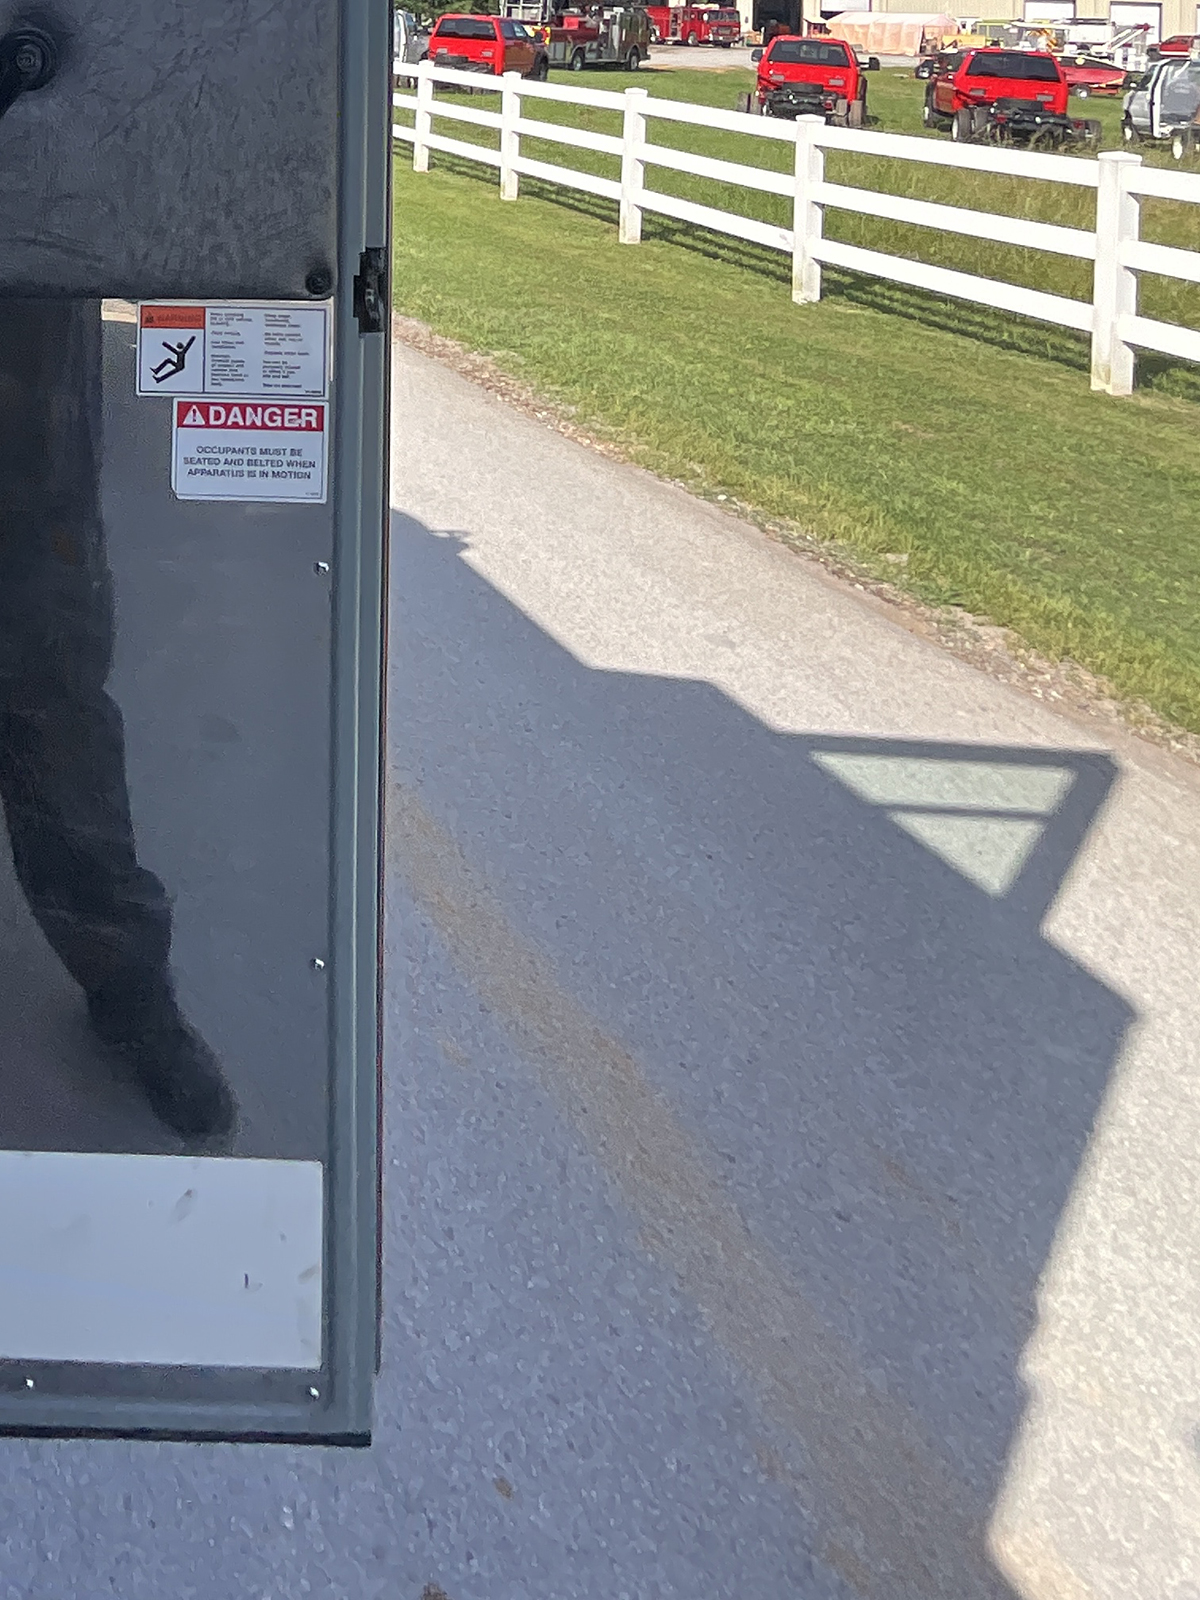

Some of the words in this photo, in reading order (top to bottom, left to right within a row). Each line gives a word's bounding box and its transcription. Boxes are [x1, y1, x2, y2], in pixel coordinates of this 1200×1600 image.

[208, 405, 318, 428] DANGER
[196, 446, 257, 456] OCCUPANTS
[259, 447, 287, 457] MUST
[290, 448, 303, 457] BE
[183, 457, 221, 466] SEATED
[223, 458, 244, 467] AND
[246, 458, 284, 468] BELTED
[286, 459, 316, 469] WHEN
[187, 468, 245, 478] APPARATUS
[247, 469, 257, 478] IS
[259, 470, 269, 479] IN
[271, 470, 311, 480] MOTION
